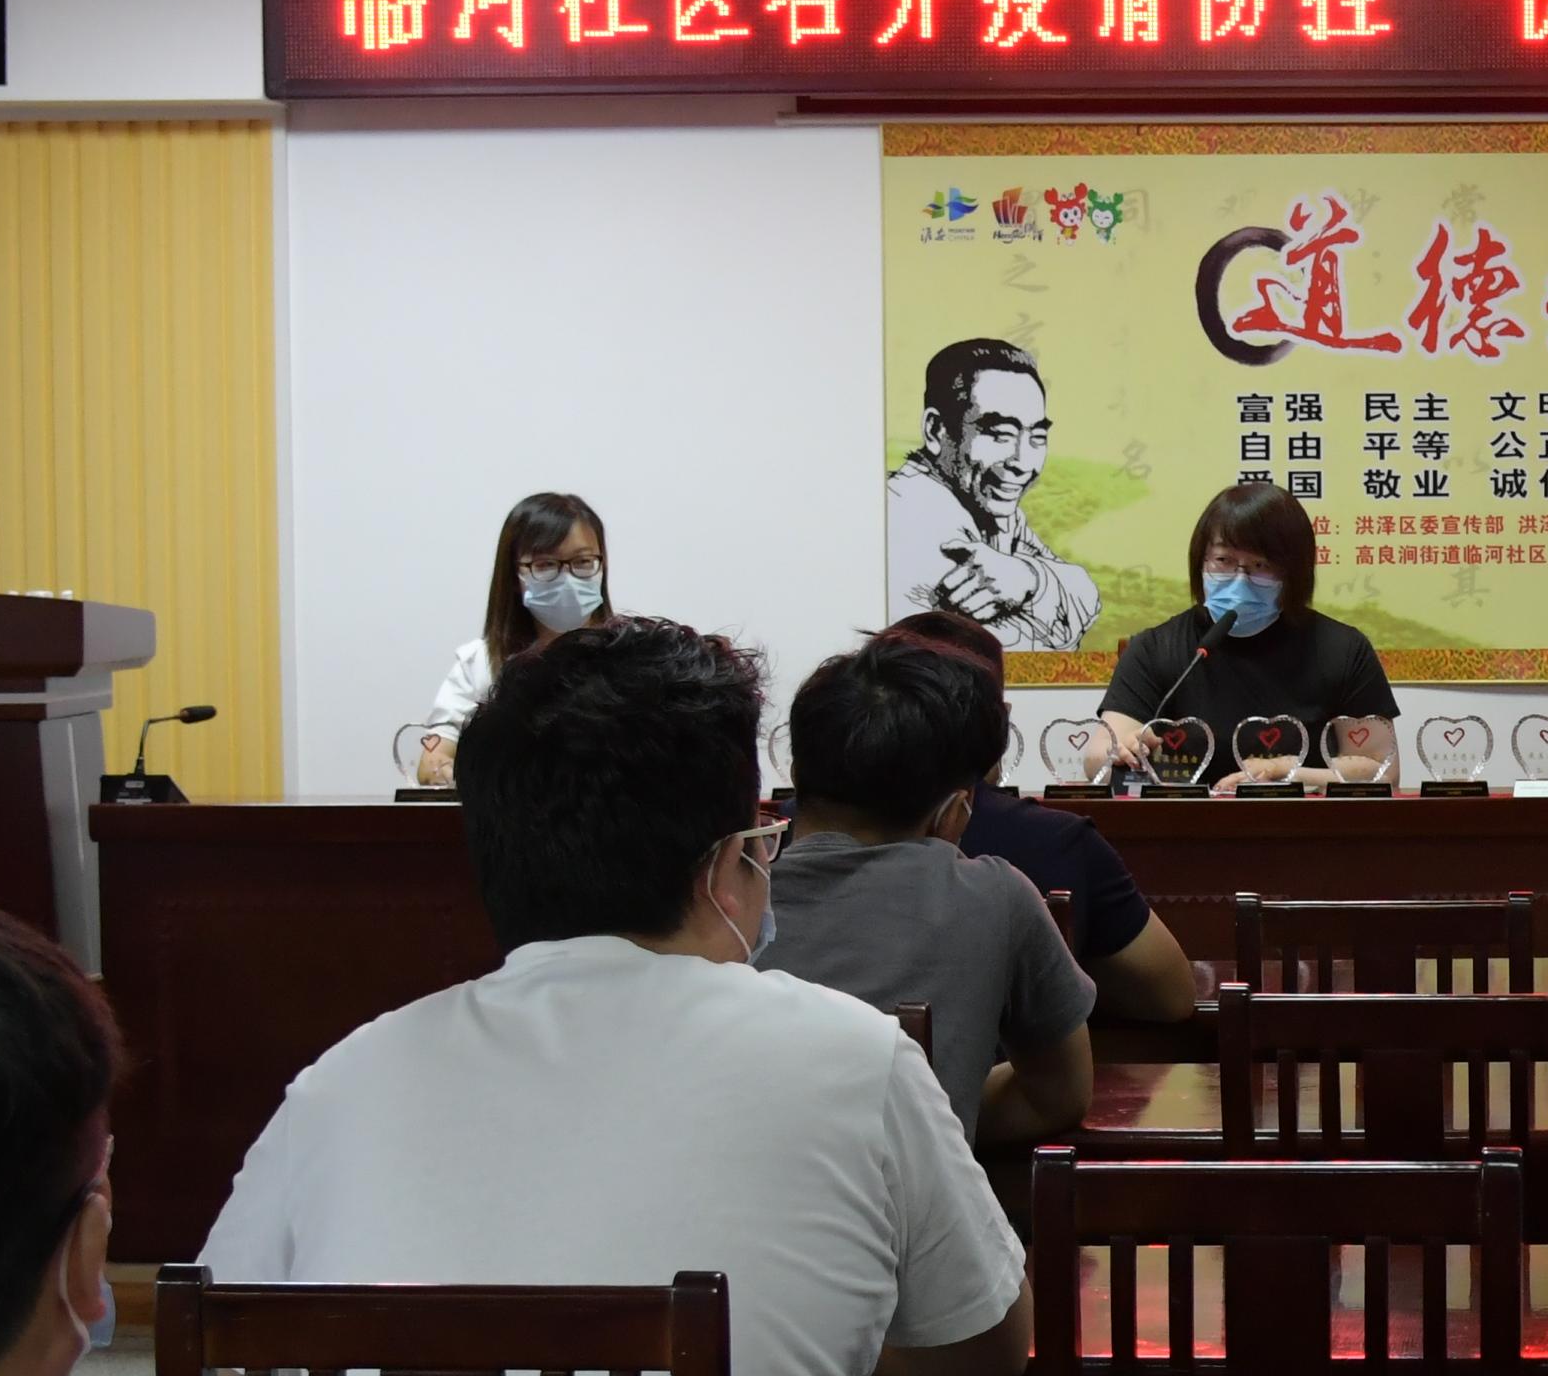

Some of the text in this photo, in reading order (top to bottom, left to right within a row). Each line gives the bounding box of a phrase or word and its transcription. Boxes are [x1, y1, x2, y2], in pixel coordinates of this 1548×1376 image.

[1237, 393, 1323, 423] 富强
[1365, 392, 1449, 422] 民主
[1241, 430, 1321, 461] 自由
[1363, 430, 1450, 460] 平等
[1363, 469, 1449, 499] 敬业
